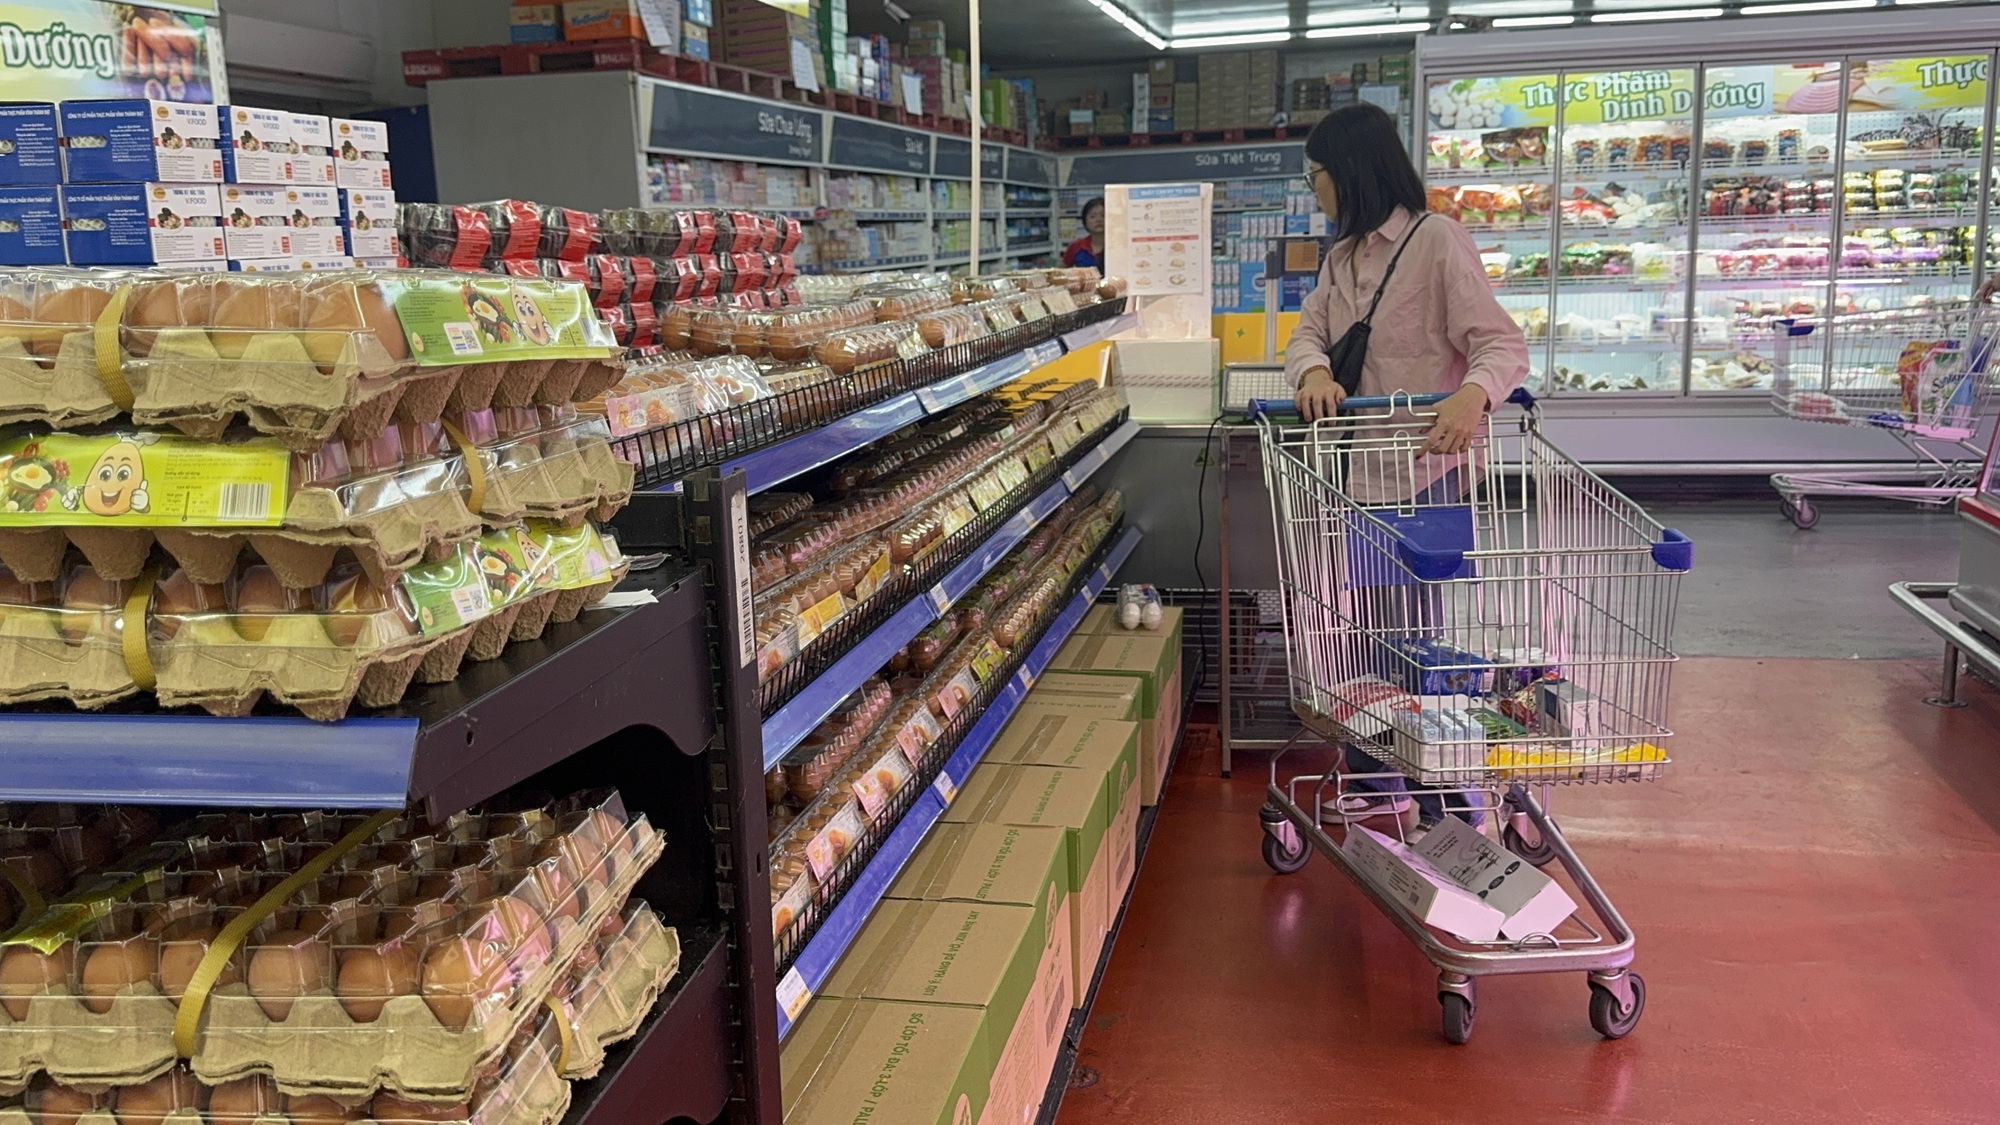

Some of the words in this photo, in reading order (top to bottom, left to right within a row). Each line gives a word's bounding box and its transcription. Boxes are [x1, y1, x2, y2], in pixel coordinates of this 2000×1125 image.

[0, 22, 115, 80] Dưỡng
[1195, 153, 1219, 166] Sữa
[1222, 152, 1244, 165] Tiệt
[1248, 151, 1281, 165] Trùng
[737, 516, 746, 563] 26801
[934, 961, 951, 978] HÀNG
[909, 1012, 924, 1024] SỐ
[900, 1026, 917, 1041] LỚP
[891, 1043, 909, 1056] TỐI
[882, 1057, 900, 1072] ĐA:
[870, 1081, 888, 1098] LỚP
